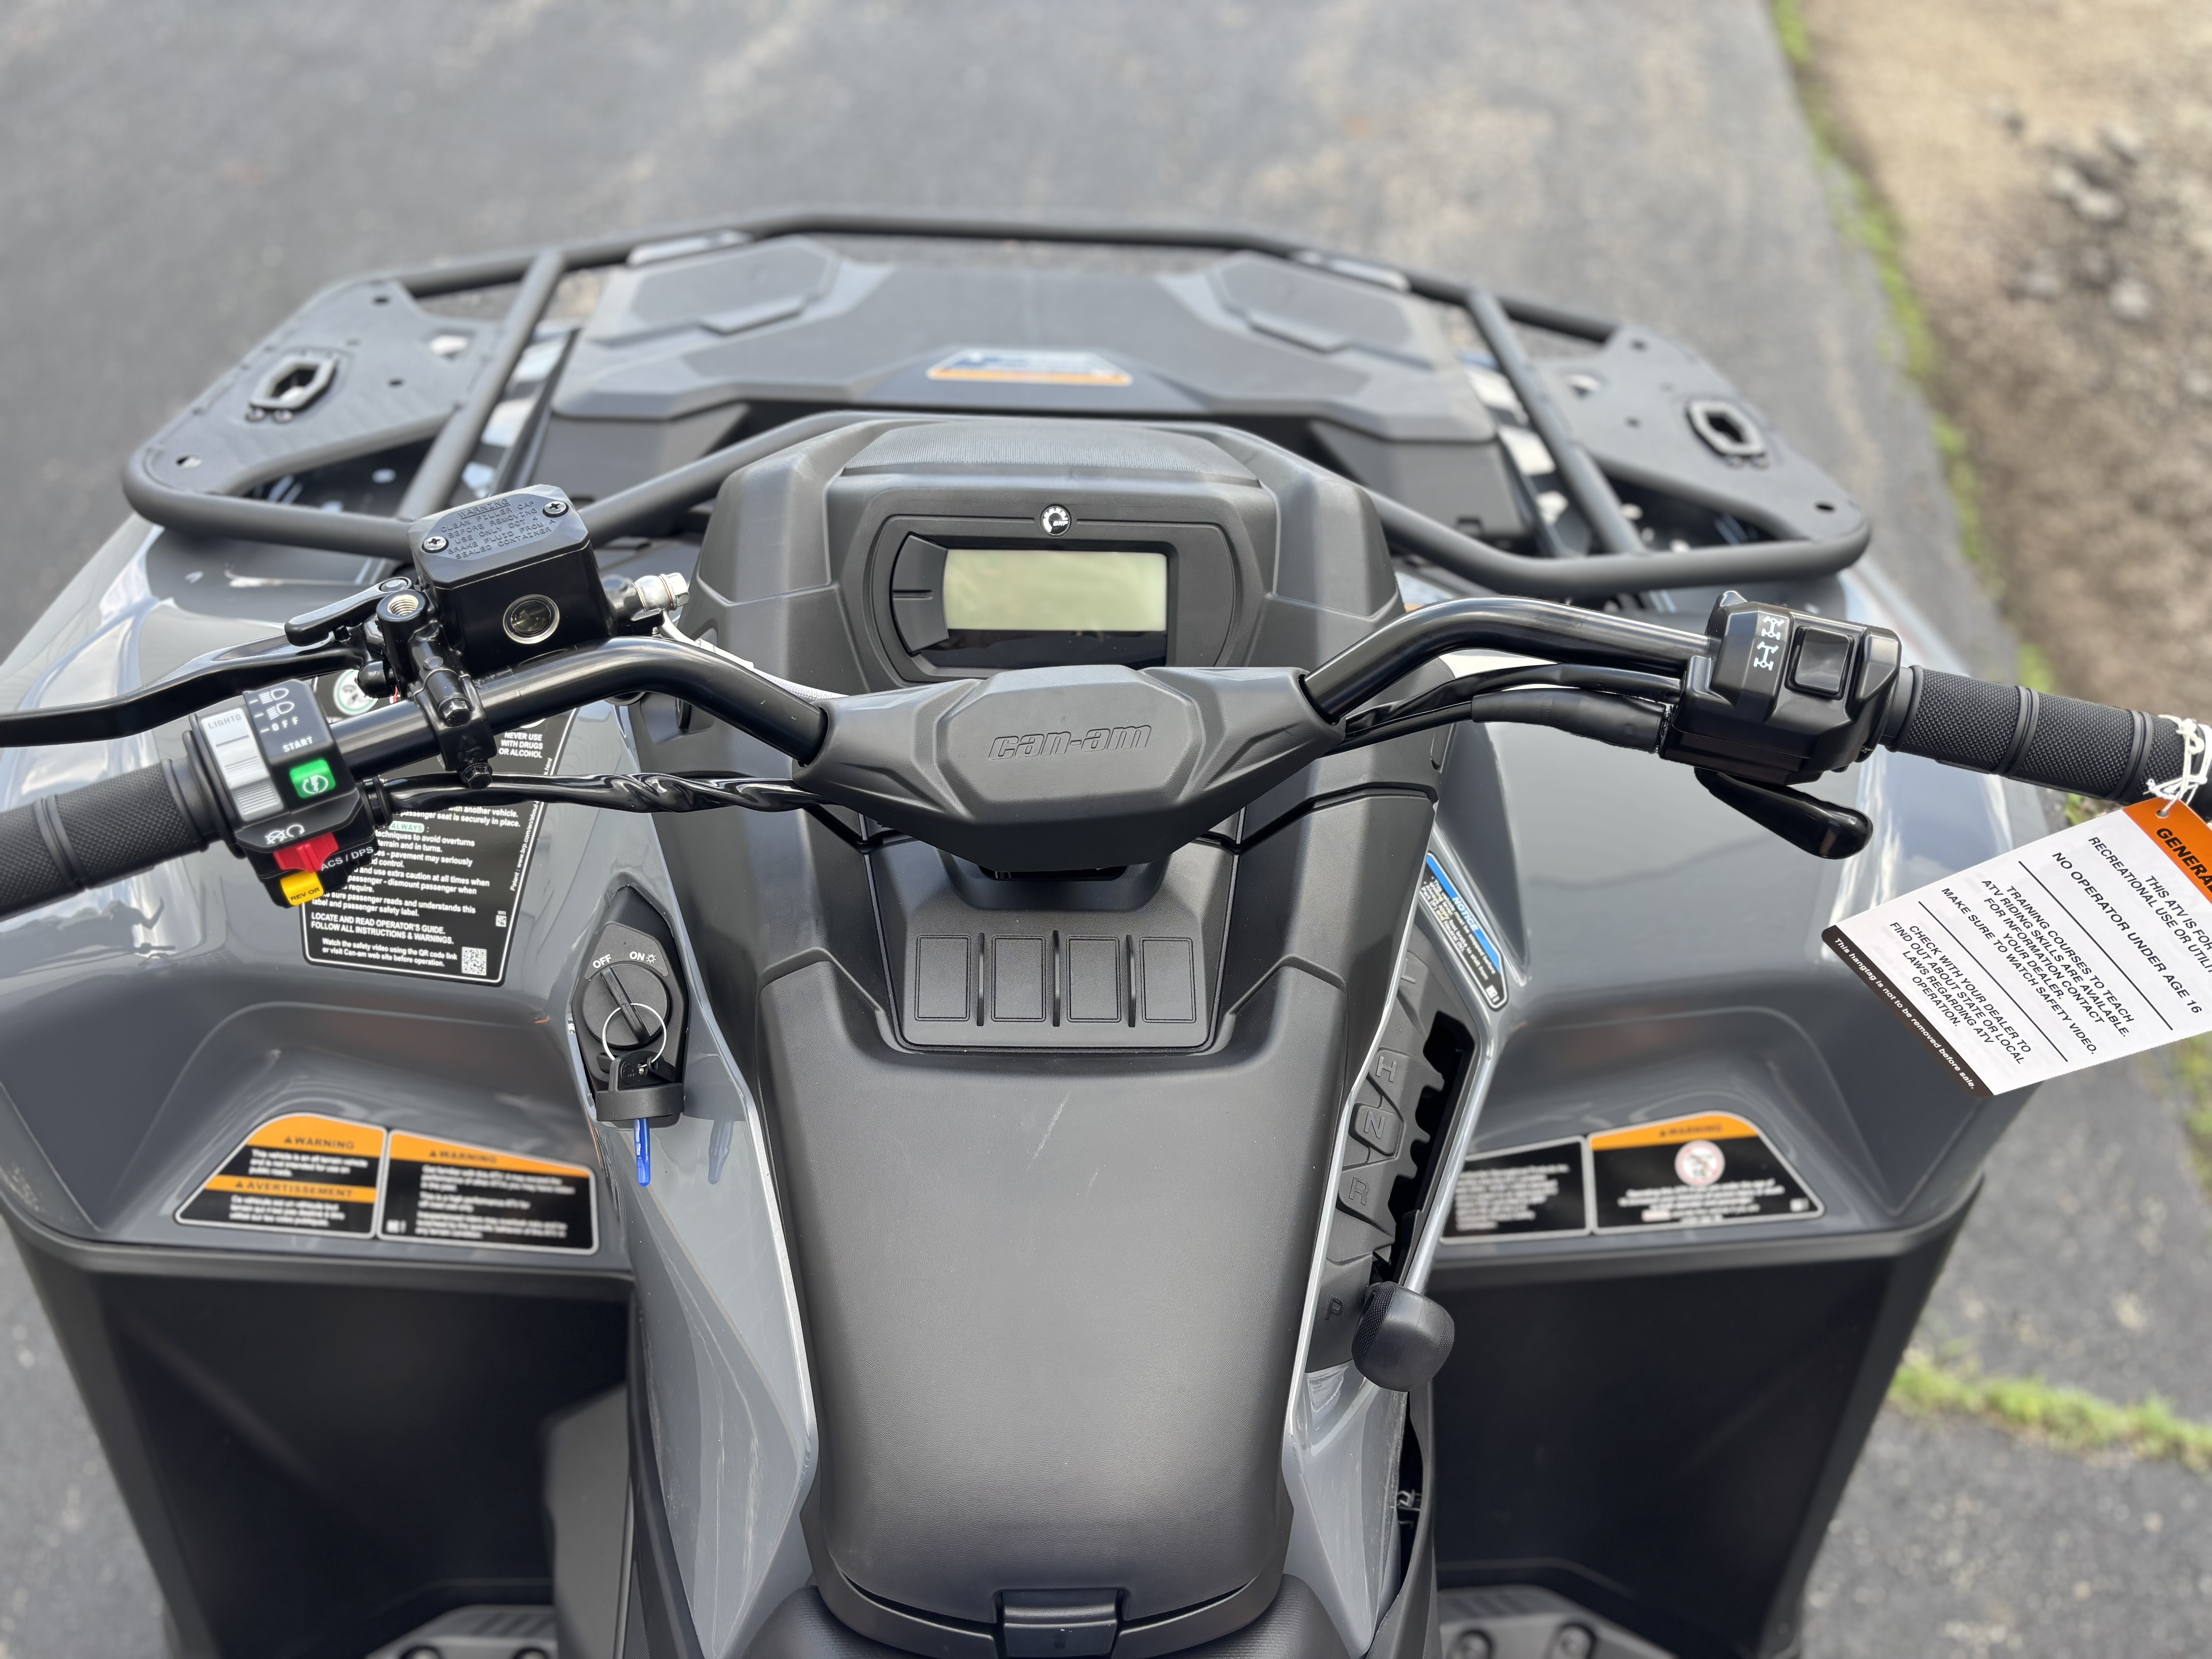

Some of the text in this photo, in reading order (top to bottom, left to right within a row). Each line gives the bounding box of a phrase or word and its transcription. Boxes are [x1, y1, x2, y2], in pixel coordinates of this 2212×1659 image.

[441, 501, 534, 532] CLEAN FILLER CAP
[457, 499, 510, 518] WARNING
[448, 508, 538, 538] BEFORE REMOVING
[454, 535, 474, 544] USE
[479, 527, 502, 537] ONLY
[508, 519, 525, 528] DOT
[447, 542, 479, 554] BRAKE
[484, 531, 514, 543] FLUID
[519, 523, 544, 533] FROM
[455, 527, 552, 559] SEALED CONTAINER
[208, 714, 241, 729] LIGHTS
[283, 737, 313, 752] START
[501, 739, 543, 750] WITH DRUGS
[504, 732, 527, 740] NEVER
[989, 725, 1151, 760] can-am
[510, 749, 543, 758] ALCOHOL
[391, 823, 423, 833] ALWAYS
[321, 857, 343, 871] ACS
[351, 847, 374, 859] DPS
[347, 875, 383, 885] passenger
[387, 878, 420, 889] dismount
[421, 883, 457, 893] passenger
[458, 886, 477, 895] when
[405, 872, 431, 880] caution
[450, 876, 470, 884] times
[471, 878, 490, 886] when
[2088, 837, 2157, 908] RECREATIONAL
[2155, 907, 2178, 928] USE
[2174, 929, 2191, 943] OR
[290, 892, 306, 901] REV
[343, 902, 378, 912] passenger
[379, 905, 400, 915] safety
[401, 907, 419, 916] label.
[347, 894, 383, 904] passenger
[418, 901, 461, 912] understands
[462, 905, 476, 914] this
[2145, 875, 2169, 898] THIS
[2164, 900, 2188, 916] ATV
[2183, 918, 2197, 929] IS
[311, 912, 445, 934] LOCATE AND READ OPERATOR'S GUIDE.
[1452, 897, 1479, 931] NOTICE
[311, 921, 340, 931] FOLLOW
[341, 924, 355, 933] ALL
[355, 926, 406, 939] INSTRUCTIONS
[414, 933, 454, 944] WARNINGS.
[2052, 852, 2202, 1013] NO OPERATOR UNDER AGE 16
[322, 938, 341, 946] Watch
[352, 942, 371, 951] safety
[372, 944, 389, 952] video
[390, 946, 407, 955] using
[343, 948, 367, 957] Can-am
[393, 954, 413, 963] before
[414, 958, 445, 967] operation.
[630, 951, 645, 961] ON
[1981, 881, 2129, 1037] ATV RIDING SKILLS ARE AVAILABLE.
[2007, 886, 2135, 1022] TRAINING COURSES TO TEACH
[593, 954, 611, 968] OFF
[1941, 888, 2097, 1054] MAKE SURE TO WATCH SAFETY VIDEO.
[1984, 898, 2105, 1022] FOR INFORMATION CONTACT
[2003, 933, 2064, 1000] YOUR DEALER.
[1890, 922, 2024, 1064] FIND OUT ABOUT STATE OR LOCAL
[1902, 951, 1994, 1042] LAWS REGARDING ATV
[1910, 926, 2031, 1052] CHECK WITH YOUR DEALER TO
[1912, 977, 1961, 1026] OPERATION.
[1835, 938, 1850, 953] This
[1849, 953, 1877, 981] hangtag
[1882, 988, 1896, 1000] not
[1894, 1000, 1903, 1008] to
[1902, 1008, 1912, 1018] be
[1911, 1018, 1941, 1048] removed
[1939, 1048, 1961, 1071] before
[1959, 1072, 1974, 1089] sale.
[1376, 1055, 1397, 1082] H
[1363, 1111, 1385, 1139] N
[295, 1136, 354, 1149] WARNING
[1349, 1176, 1370, 1206] R
[1325, 1295, 1344, 1321] P
